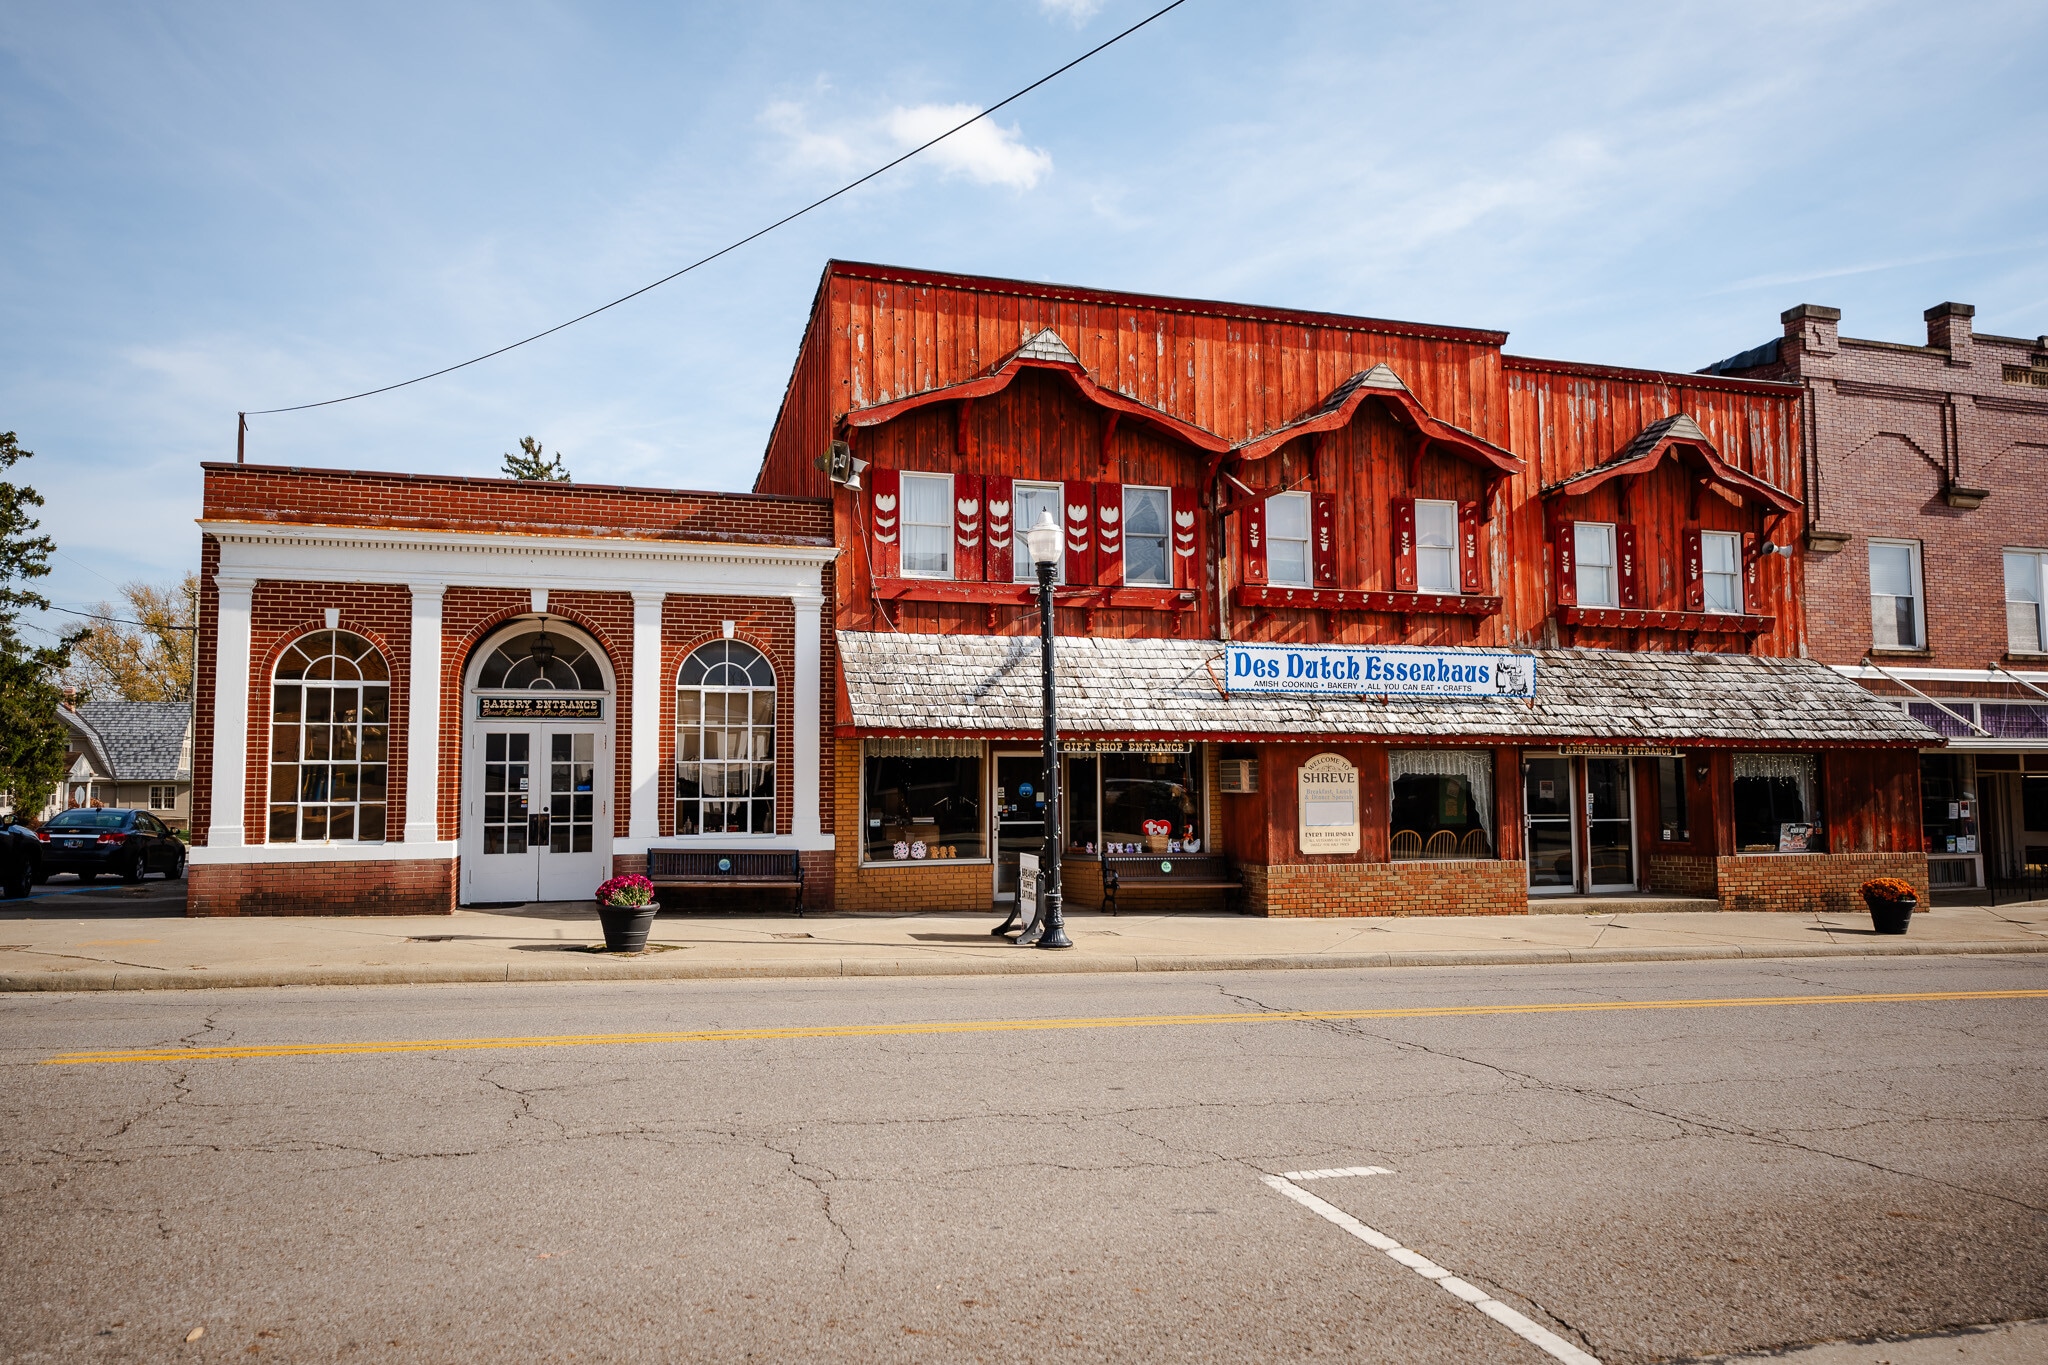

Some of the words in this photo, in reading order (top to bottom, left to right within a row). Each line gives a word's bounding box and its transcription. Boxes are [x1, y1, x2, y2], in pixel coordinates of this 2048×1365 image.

[1234, 652, 1280, 678] Des
[1286, 653, 1360, 681] Dutch
[1365, 656, 1490, 683] Essenhaus
[1282, 681, 1319, 689] COOKING
[482, 700, 532, 709] BAKERY
[536, 700, 598, 709] ENTRANCE
[1063, 742, 1091, 751] GIFT
[1095, 743, 1123, 751] SHOP
[1128, 743, 1184, 752] ENTRANCE
[1565, 746, 1623, 755] RESTAURANT
[1627, 747, 1672, 755] ENTRANCE
[1308, 757, 1340, 771] WELCOME
[1341, 762, 1350, 771] TO
[1303, 772, 1355, 783] SHREVE
